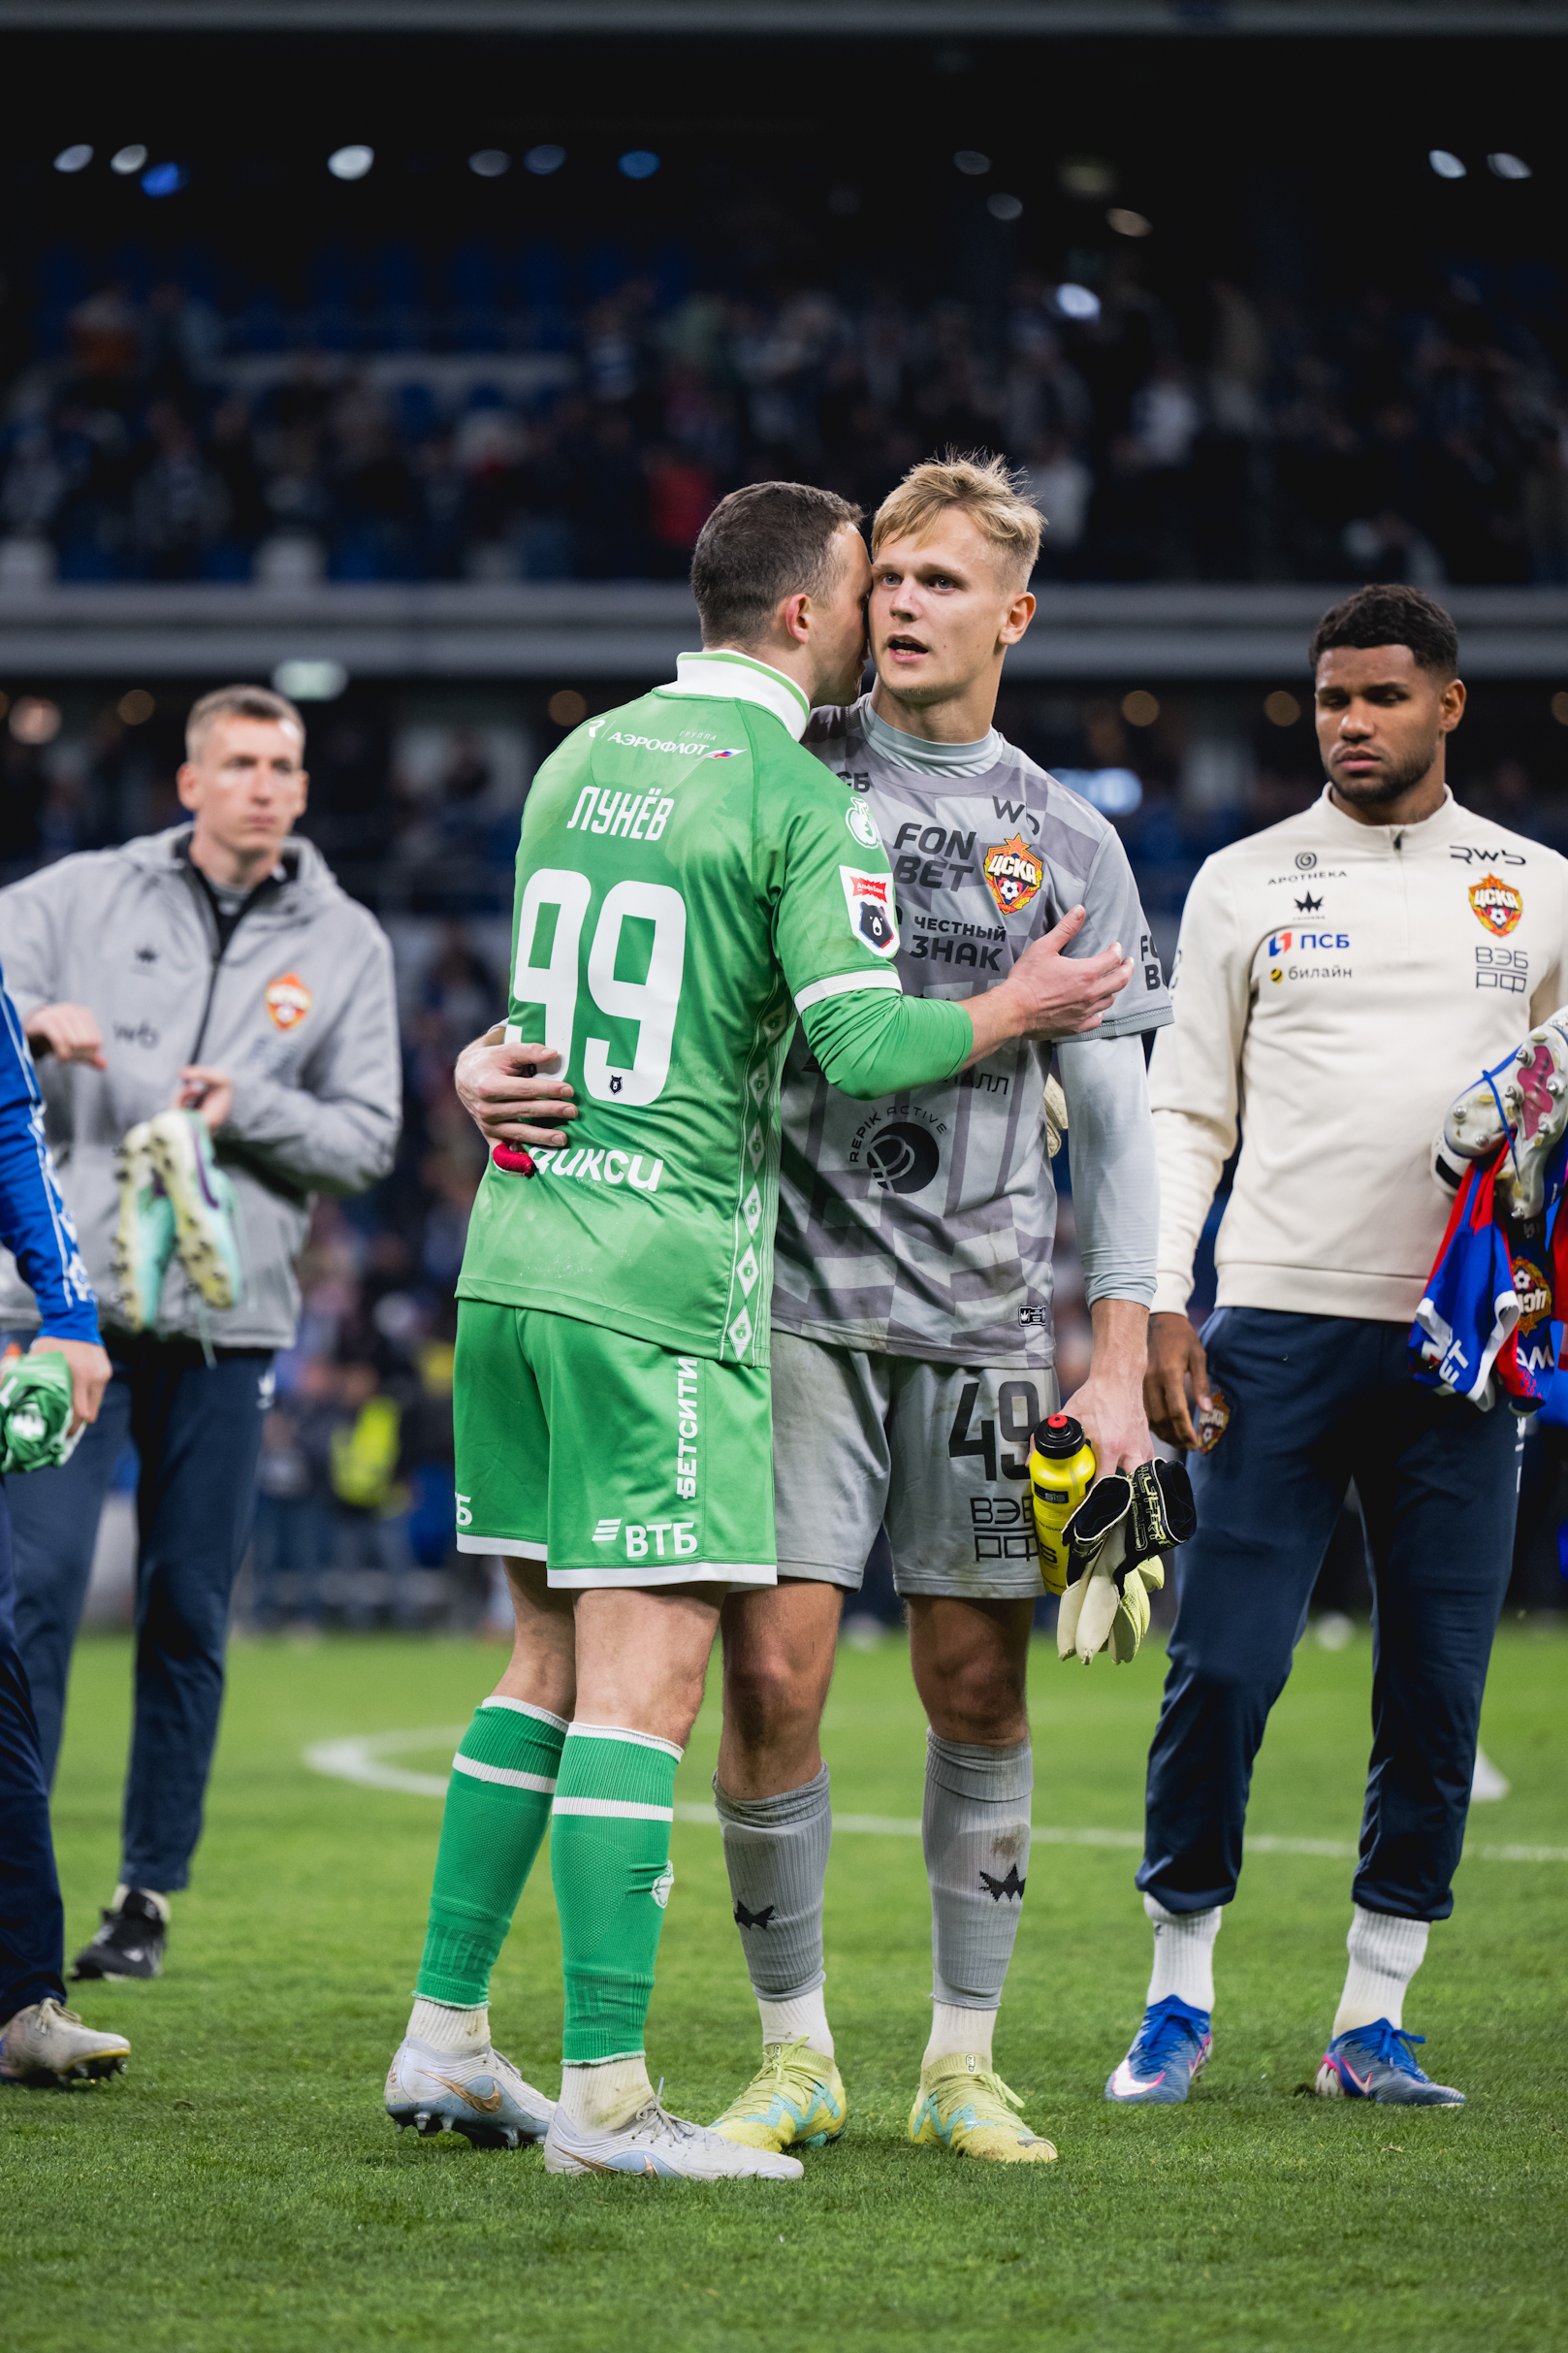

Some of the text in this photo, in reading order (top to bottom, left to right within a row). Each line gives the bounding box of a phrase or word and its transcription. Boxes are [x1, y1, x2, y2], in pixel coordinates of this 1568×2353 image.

[607, 731, 711, 756] АЭРОФЛОТ
[679, 730, 717, 741] ГРУППА
[566, 786, 675, 841] ЛУНЁВ
[893, 822, 976, 860] FON
[892, 854, 975, 892] BET
[987, 854, 1038, 886] ЦСКА
[1267, 870, 1348, 886] APOTHEKA
[1473, 888, 1520, 910] ЦСКА
[913, 915, 1007, 943] ЧЕСТНЫЙ
[1299, 934, 1351, 950] ПСБ
[910, 934, 1005, 972] ЗНАК
[1475, 947, 1529, 970] ВЭБ
[503, 867, 688, 1107] 99
[1288, 965, 1353, 981] билайн
[1475, 972, 1527, 994] РФ
[848, 1105, 948, 1163] REPIK ACTIVE
[676, 1357, 699, 1500] БЕТСИТИ
[947, 1379, 1040, 1482] 49
[624, 1521, 698, 1559] ВТБ
